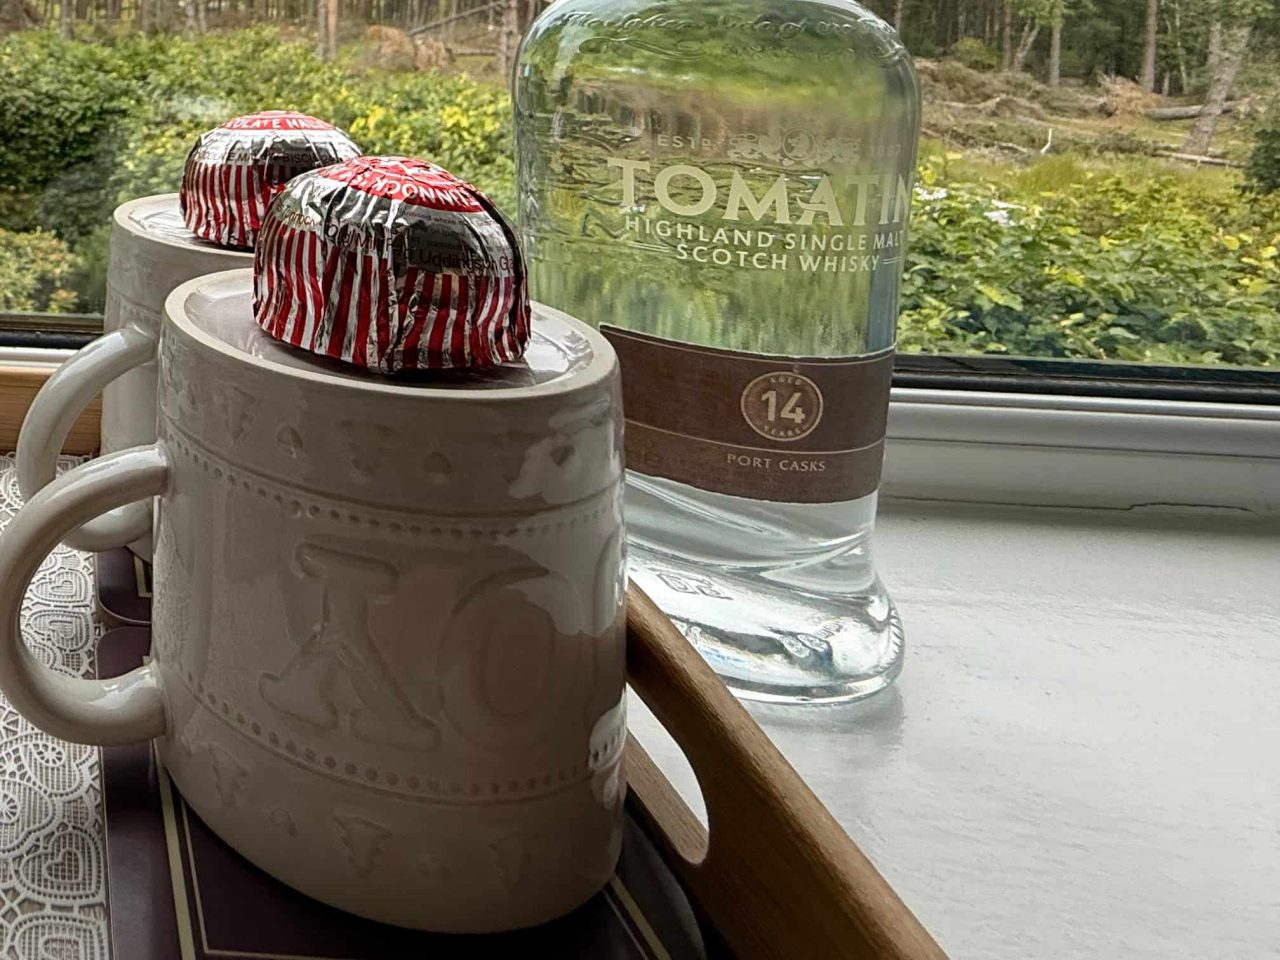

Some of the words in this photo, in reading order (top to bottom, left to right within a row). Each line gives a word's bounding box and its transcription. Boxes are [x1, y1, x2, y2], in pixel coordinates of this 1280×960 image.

[624, 215, 774, 248] HIGHLAND
[785, 233, 867, 252] SINGLE
[676, 243, 788, 271] SCOTCH
[799, 254, 880, 273] WHISKY
[761, 389, 807, 424] 14
[727, 453, 772, 470] PORT
[780, 459, 827, 473] CASKS
